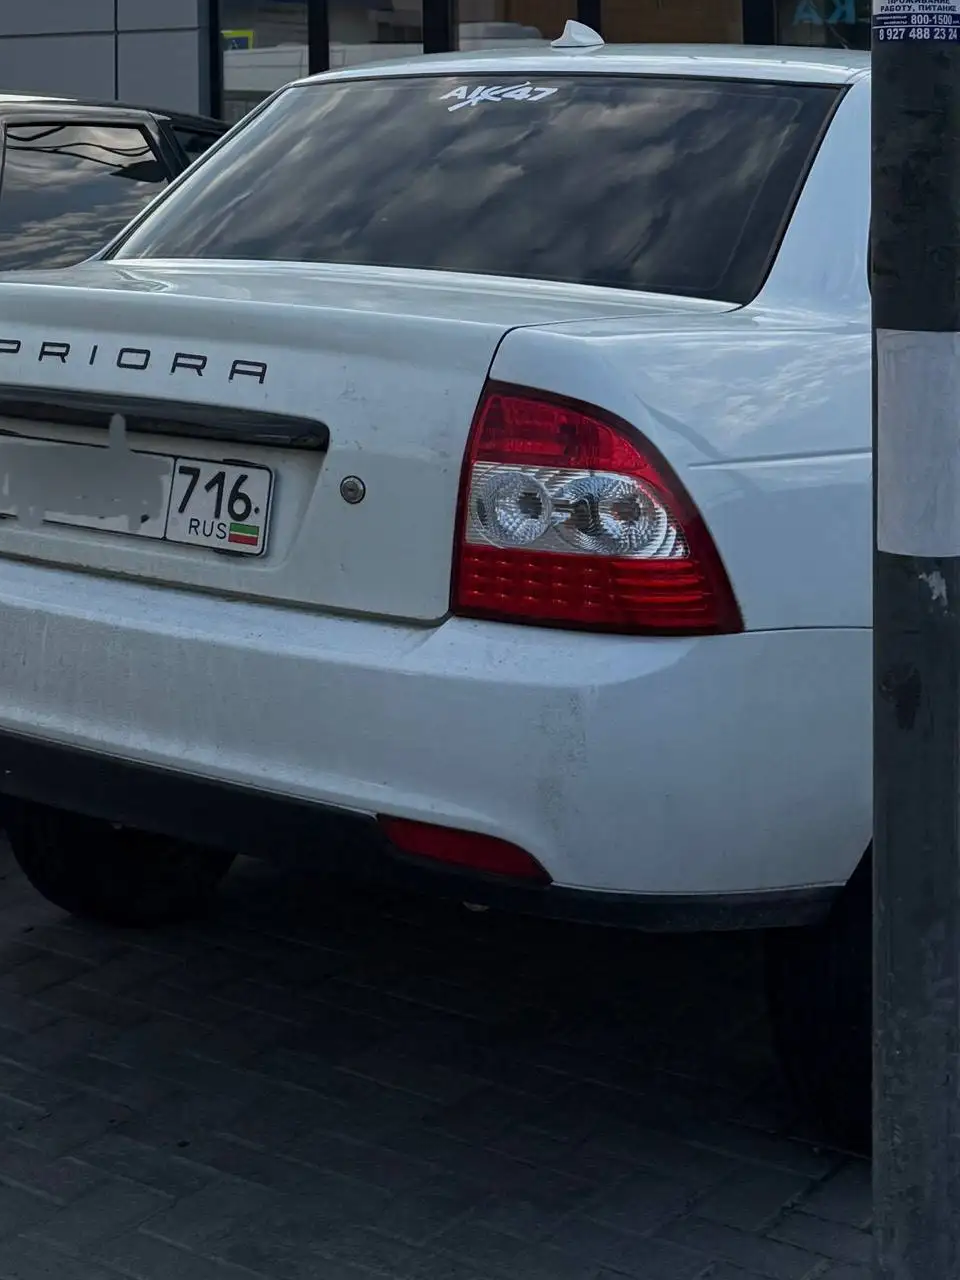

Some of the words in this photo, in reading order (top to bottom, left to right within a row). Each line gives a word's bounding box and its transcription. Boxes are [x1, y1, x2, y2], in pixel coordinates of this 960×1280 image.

[880, 4, 916, 12] РАБОТУ,
[910, 14, 953, 25] 800-1500
[879, 28, 885, 40] 8
[886, 28, 906, 40] 927
[908, 27, 931, 40] 488
[933, 27, 946, 40] 23
[948, 28, 958, 40] 24
[178, 465, 252, 522] 716
[188, 518, 227, 540] RUS
